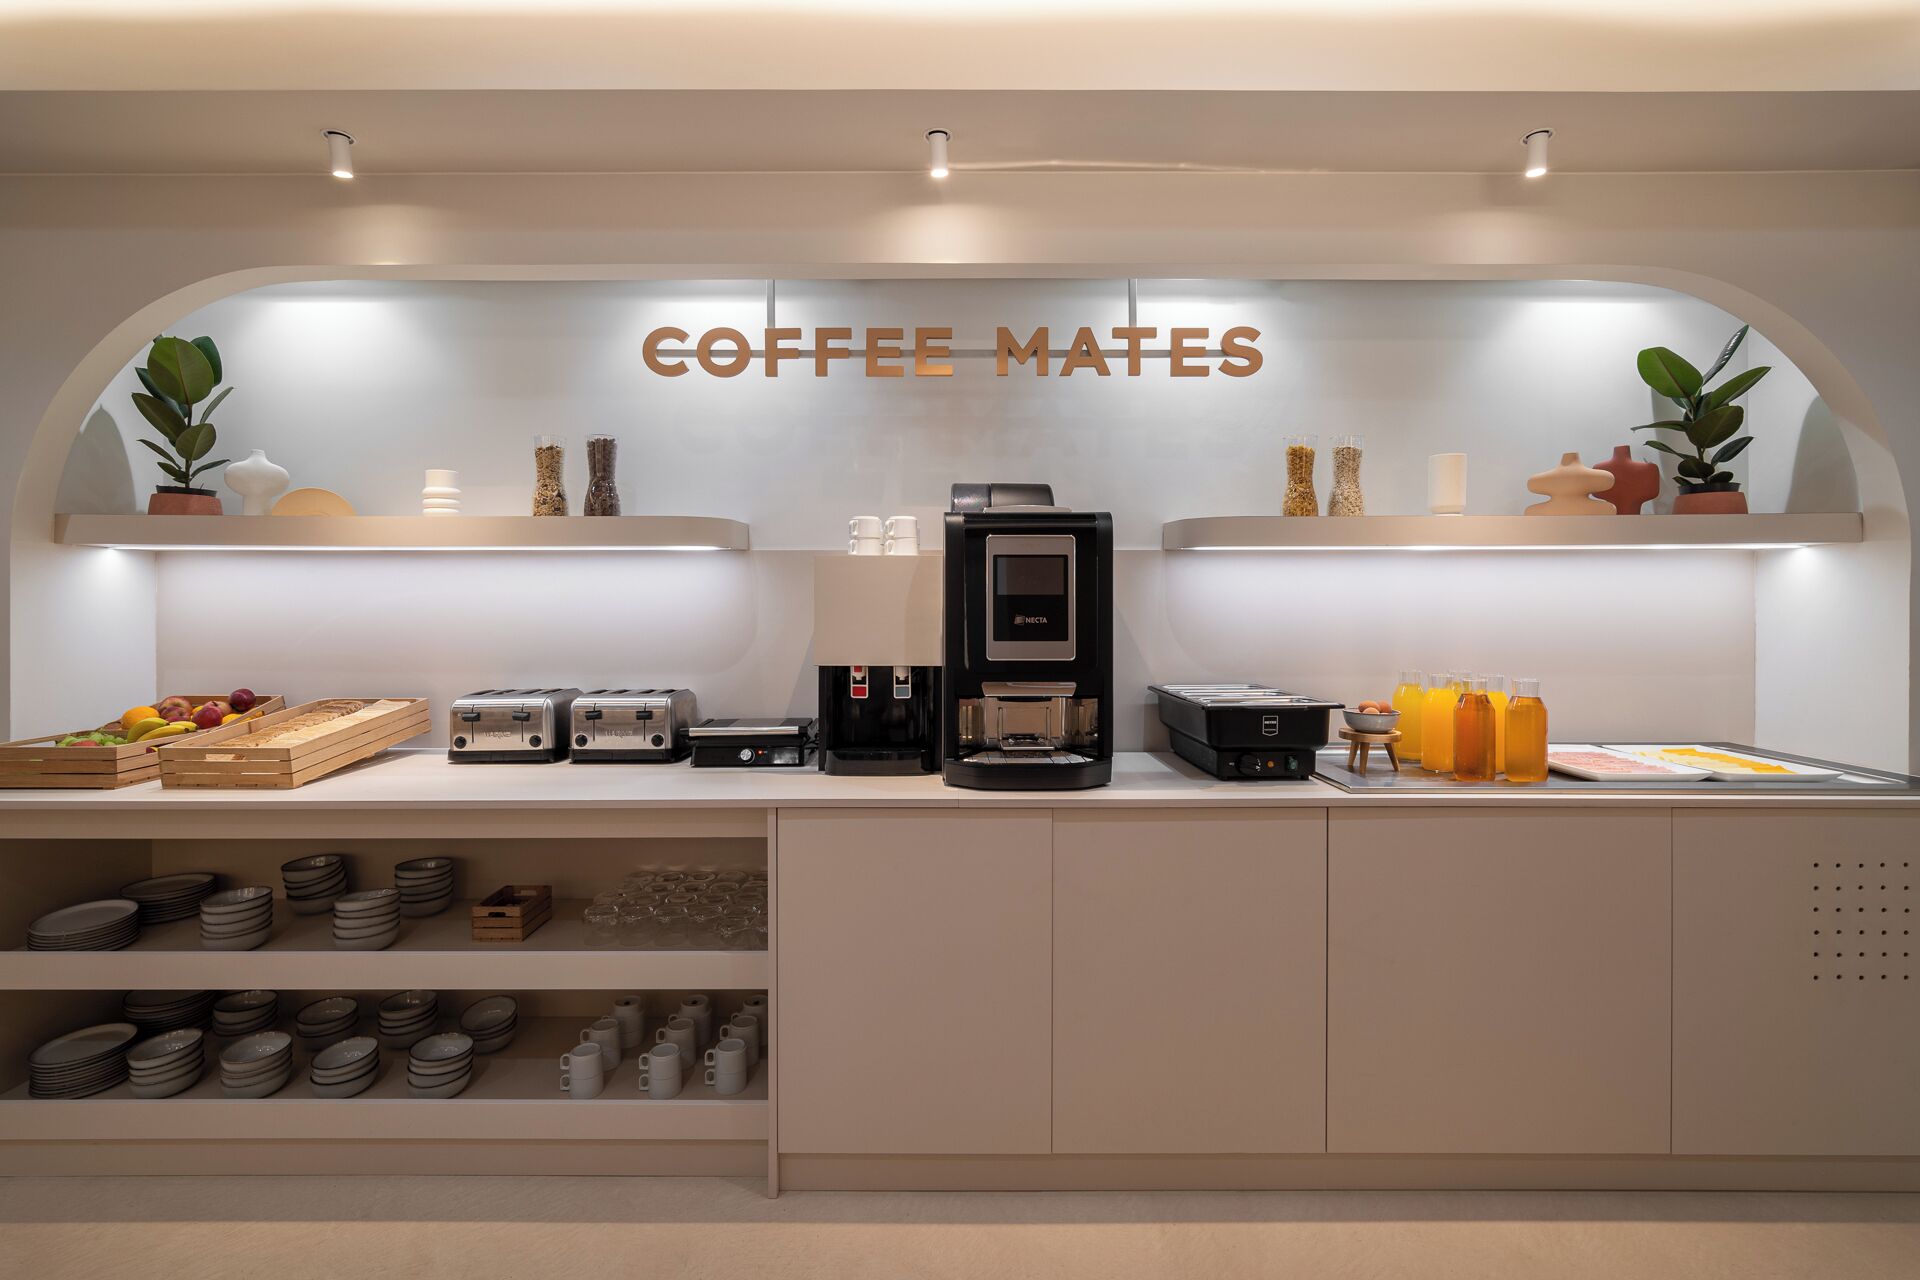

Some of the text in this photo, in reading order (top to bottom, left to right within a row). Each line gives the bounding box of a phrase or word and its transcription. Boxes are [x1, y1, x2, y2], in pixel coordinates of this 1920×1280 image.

[642, 327, 1264, 378] COFFEE MATES
[1025, 616, 1048, 624] NECTA
